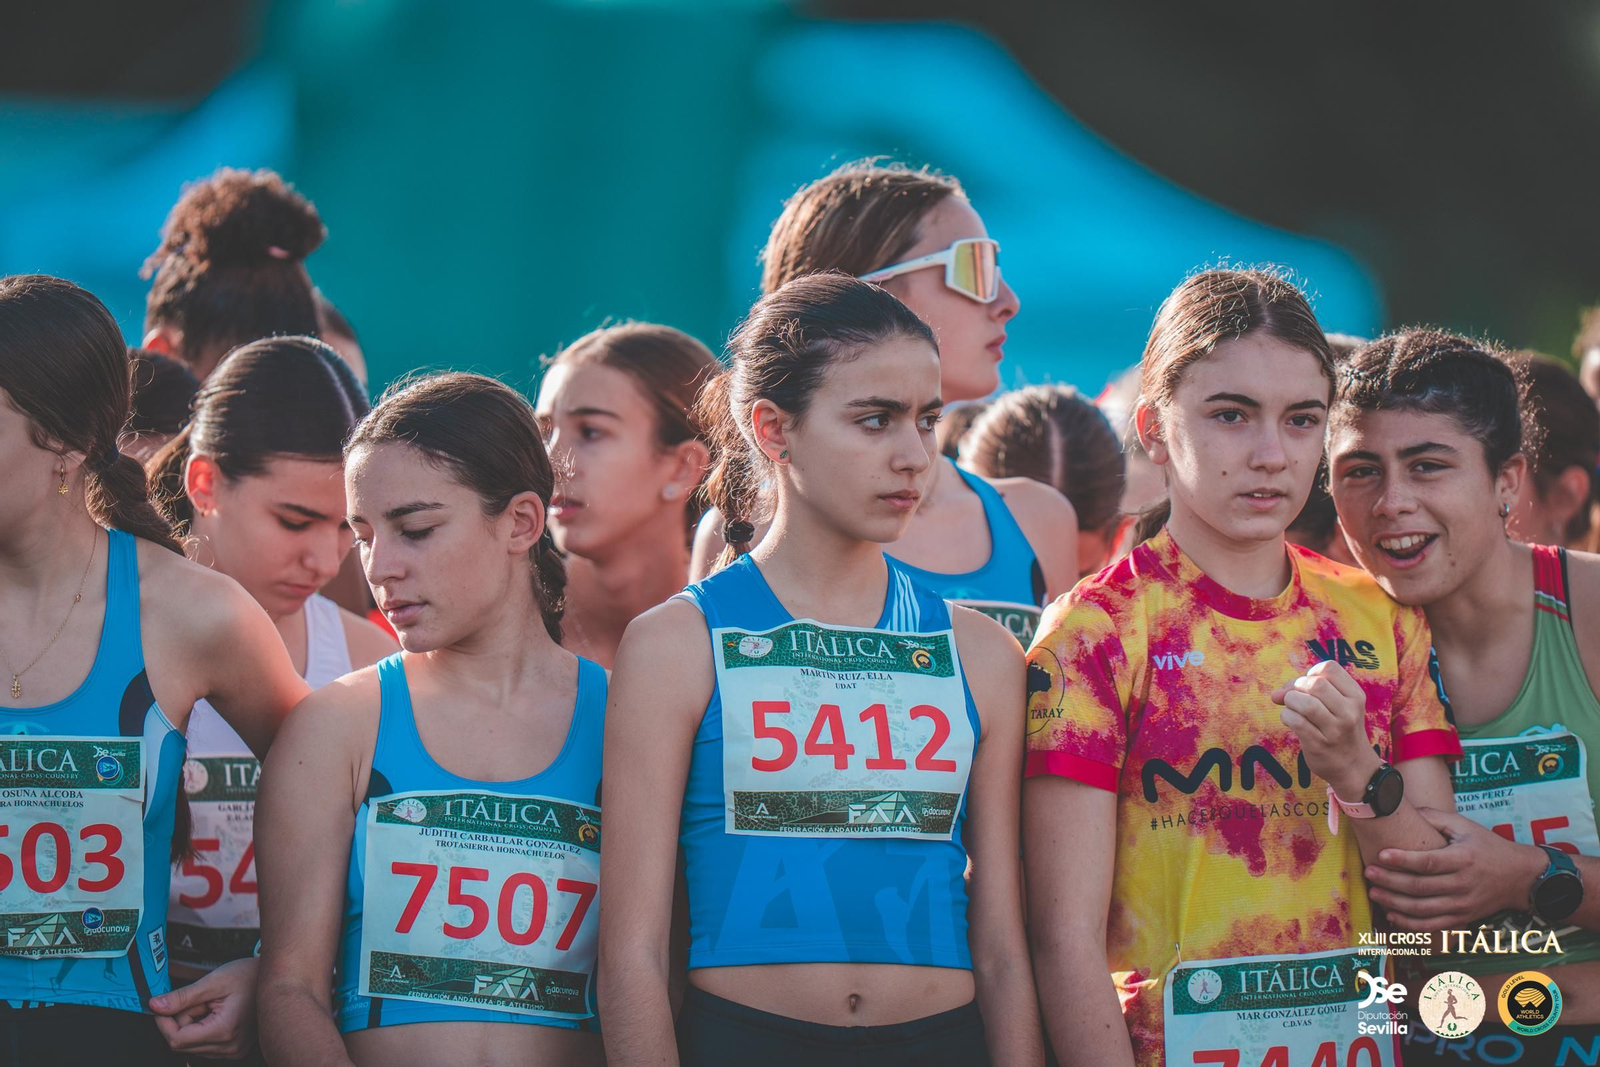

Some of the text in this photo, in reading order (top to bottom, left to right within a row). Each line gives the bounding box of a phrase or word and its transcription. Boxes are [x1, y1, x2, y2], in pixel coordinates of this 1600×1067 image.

[789, 629, 896, 660] ITÁLICA
[868, 657, 898, 665] COUNTRY
[1152, 650, 1204, 671] vive
[1304, 638, 1380, 670] VAS
[800, 668, 836, 680] MARTÍN
[867, 672, 893, 680] ELLA
[1031, 708, 1064, 720] TARAY
[751, 701, 957, 773] 5412
[2, 789, 84, 799] OSUNA ALCOBA
[1482, 788, 1514, 800] PEREZ
[14, 800, 84, 808] HORNACHUELOS
[444, 796, 562, 829] ITÁLICA
[1478, 799, 1512, 810] ATARFE
[444, 817, 562, 835] INTERNATIONAL CROSS COUNTRY
[779, 824, 827, 834] FEDERACIÓN
[828, 826, 871, 834] ANDALUZA
[885, 826, 922, 834] ATLETISMO
[418, 828, 582, 856] JUDITH CARBALLAR GONZALEZ
[435, 840, 566, 860] TROTASIERRA HORNACHUELOS
[391, 861, 599, 951] 7507
[1238, 963, 1345, 994] ITÁLICA
[408, 990, 545, 1011] FEDERACIÓN ANDALUZA DE ATLETISMO
[1241, 986, 1346, 1001] INTERNATIONAL CROSS COUNTRY
[1237, 1004, 1347, 1021] MAR GONZÁLEZ GÓMEZ
[1282, 1019, 1312, 1028] C.D.VAS
